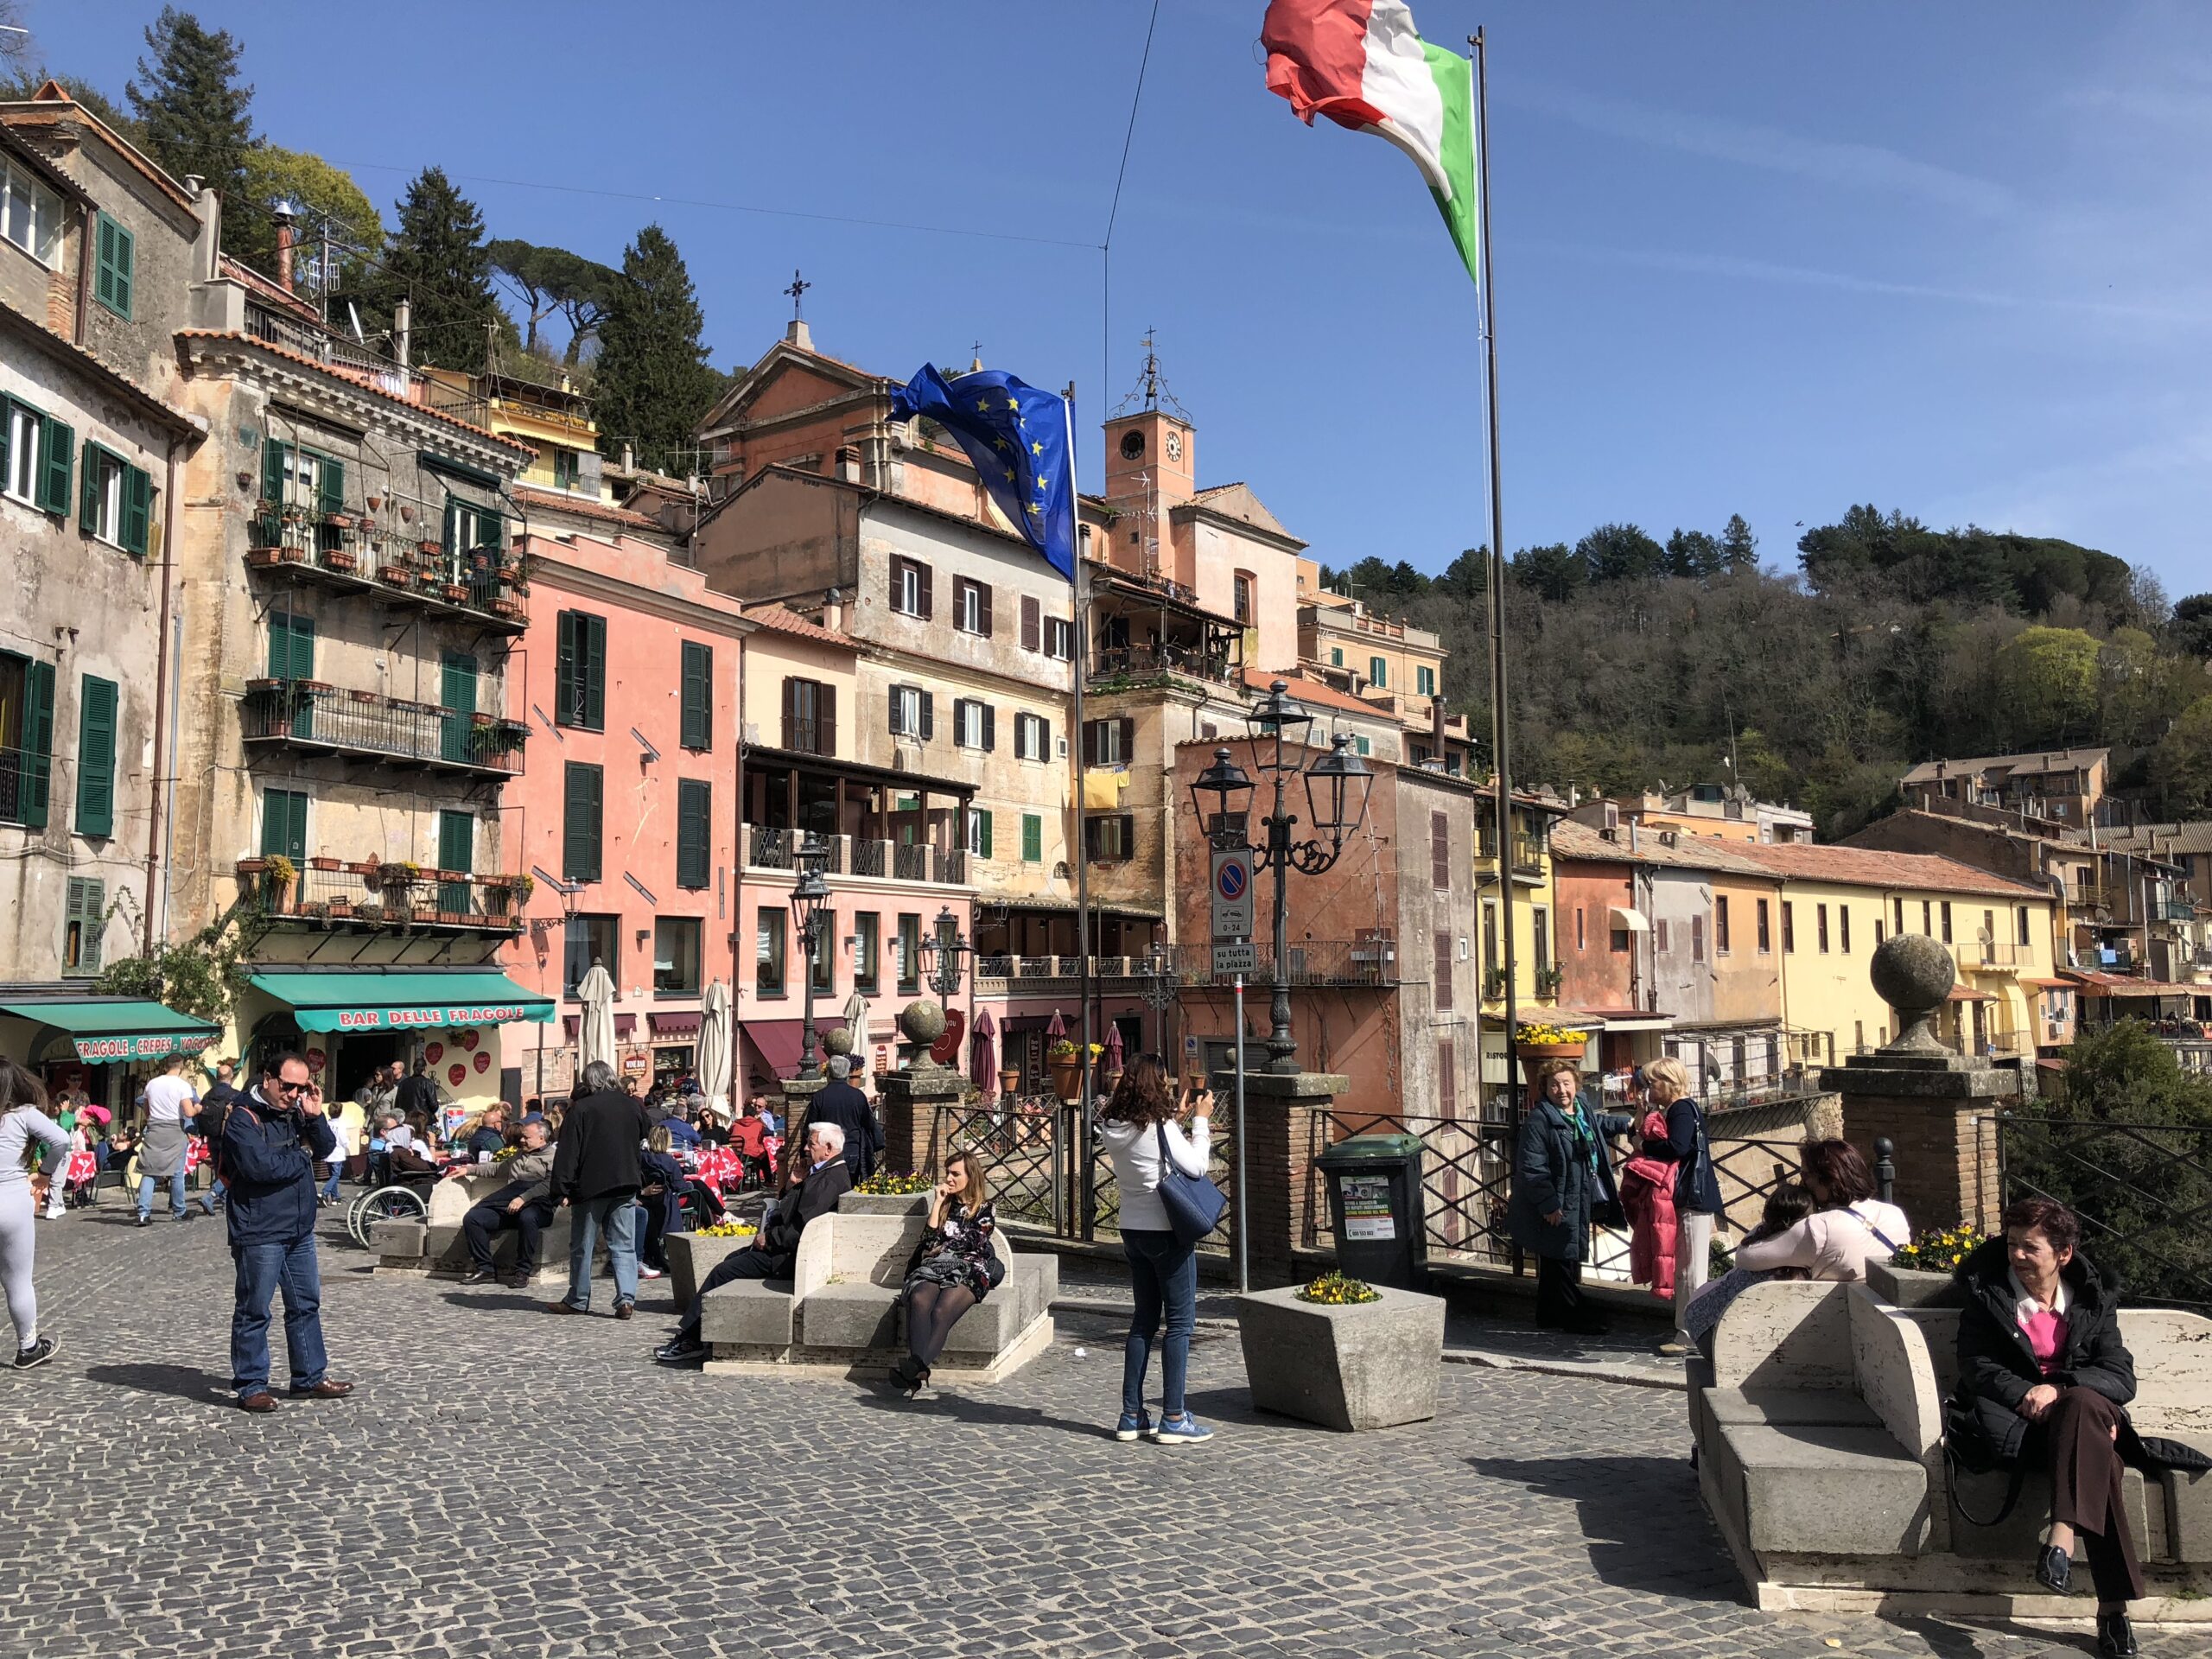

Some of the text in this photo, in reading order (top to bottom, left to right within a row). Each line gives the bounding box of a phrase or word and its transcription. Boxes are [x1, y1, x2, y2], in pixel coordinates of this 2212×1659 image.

[1229, 949, 1250, 957] tutta
[1226, 959, 1252, 969] piazza
[339, 1007, 524, 1027] BAR DELLE FRAGOLE
[76, 1039, 129, 1058] FRAGOLE
[137, 1037, 172, 1055] CREPES
